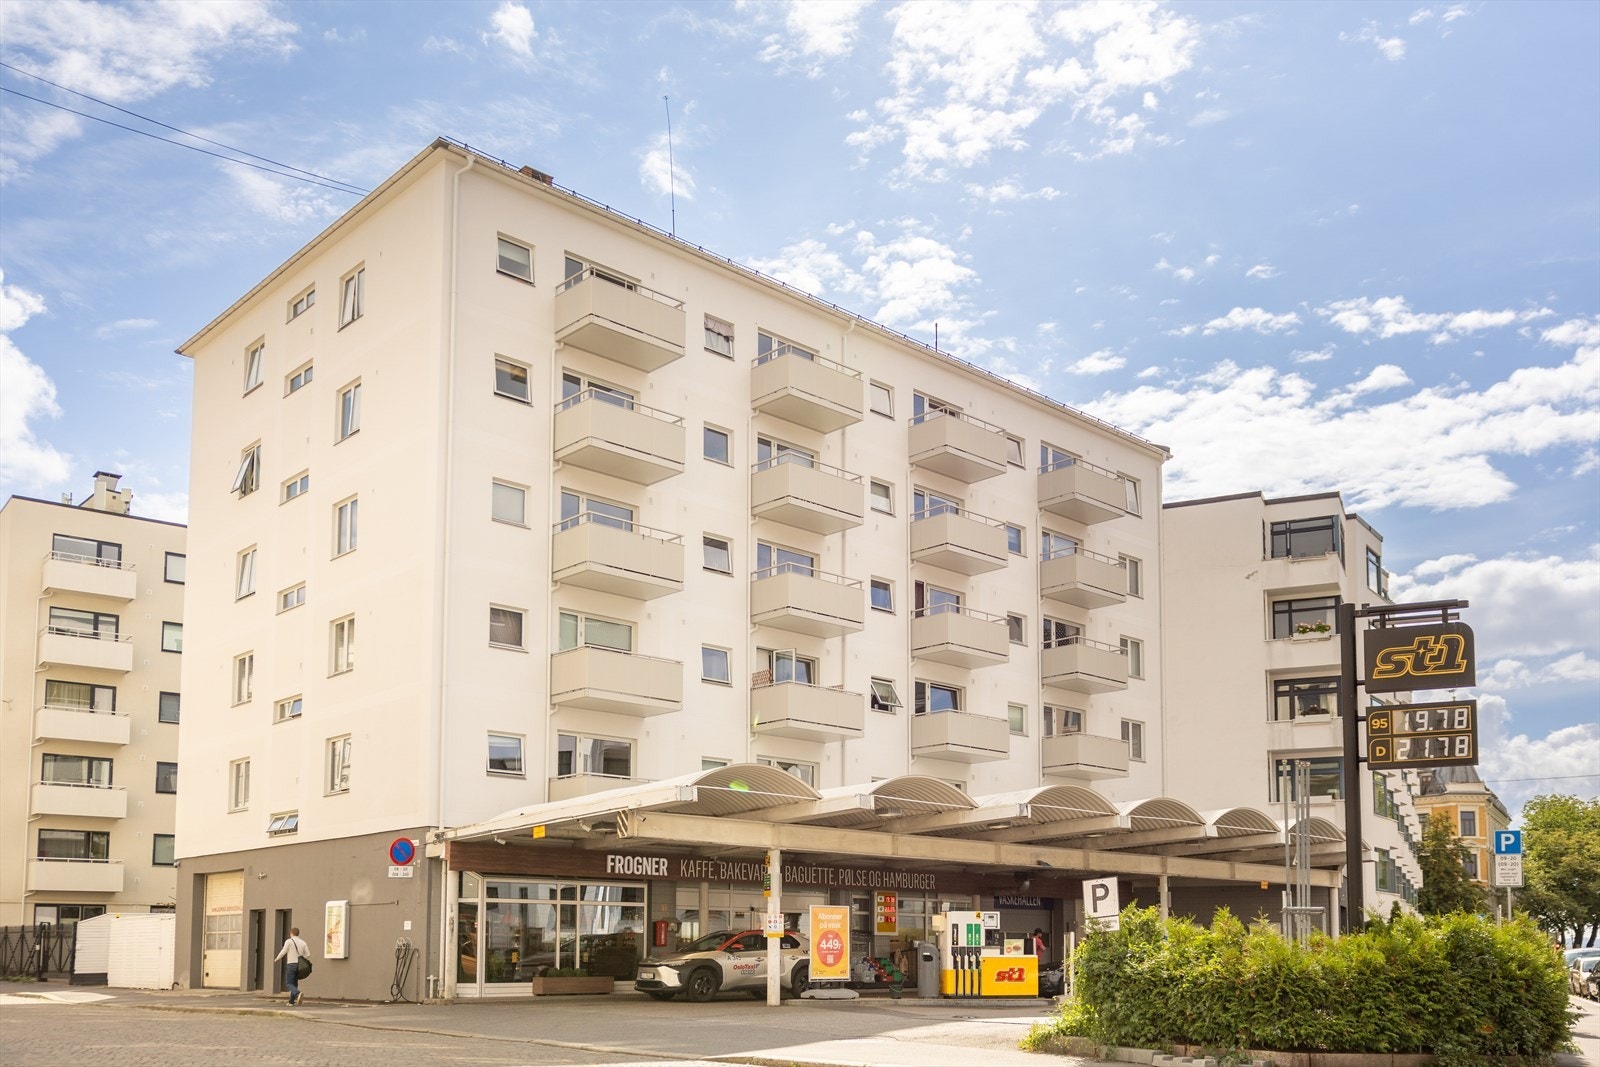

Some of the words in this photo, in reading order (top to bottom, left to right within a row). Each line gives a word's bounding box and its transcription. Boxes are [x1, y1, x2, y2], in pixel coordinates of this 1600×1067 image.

[1372, 634, 1467, 679] st1
[1371, 718, 1388, 729] 95
[1404, 708, 1468, 732] 19.78
[1375, 746, 1386, 757] D
[1396, 735, 1469, 760] 21.78
[1501, 833, 1515, 852] P
[607, 855, 668, 876] FROGNER
[680, 859, 718, 880] KAFFE,
[784, 865, 837, 887] BAGUETTE,
[838, 868, 867, 887] PØLSE
[869, 870, 881, 887] OG
[883, 871, 936, 890] HAMBURGER
[1091, 883, 1109, 913] P
[994, 967, 1026, 983] st1
